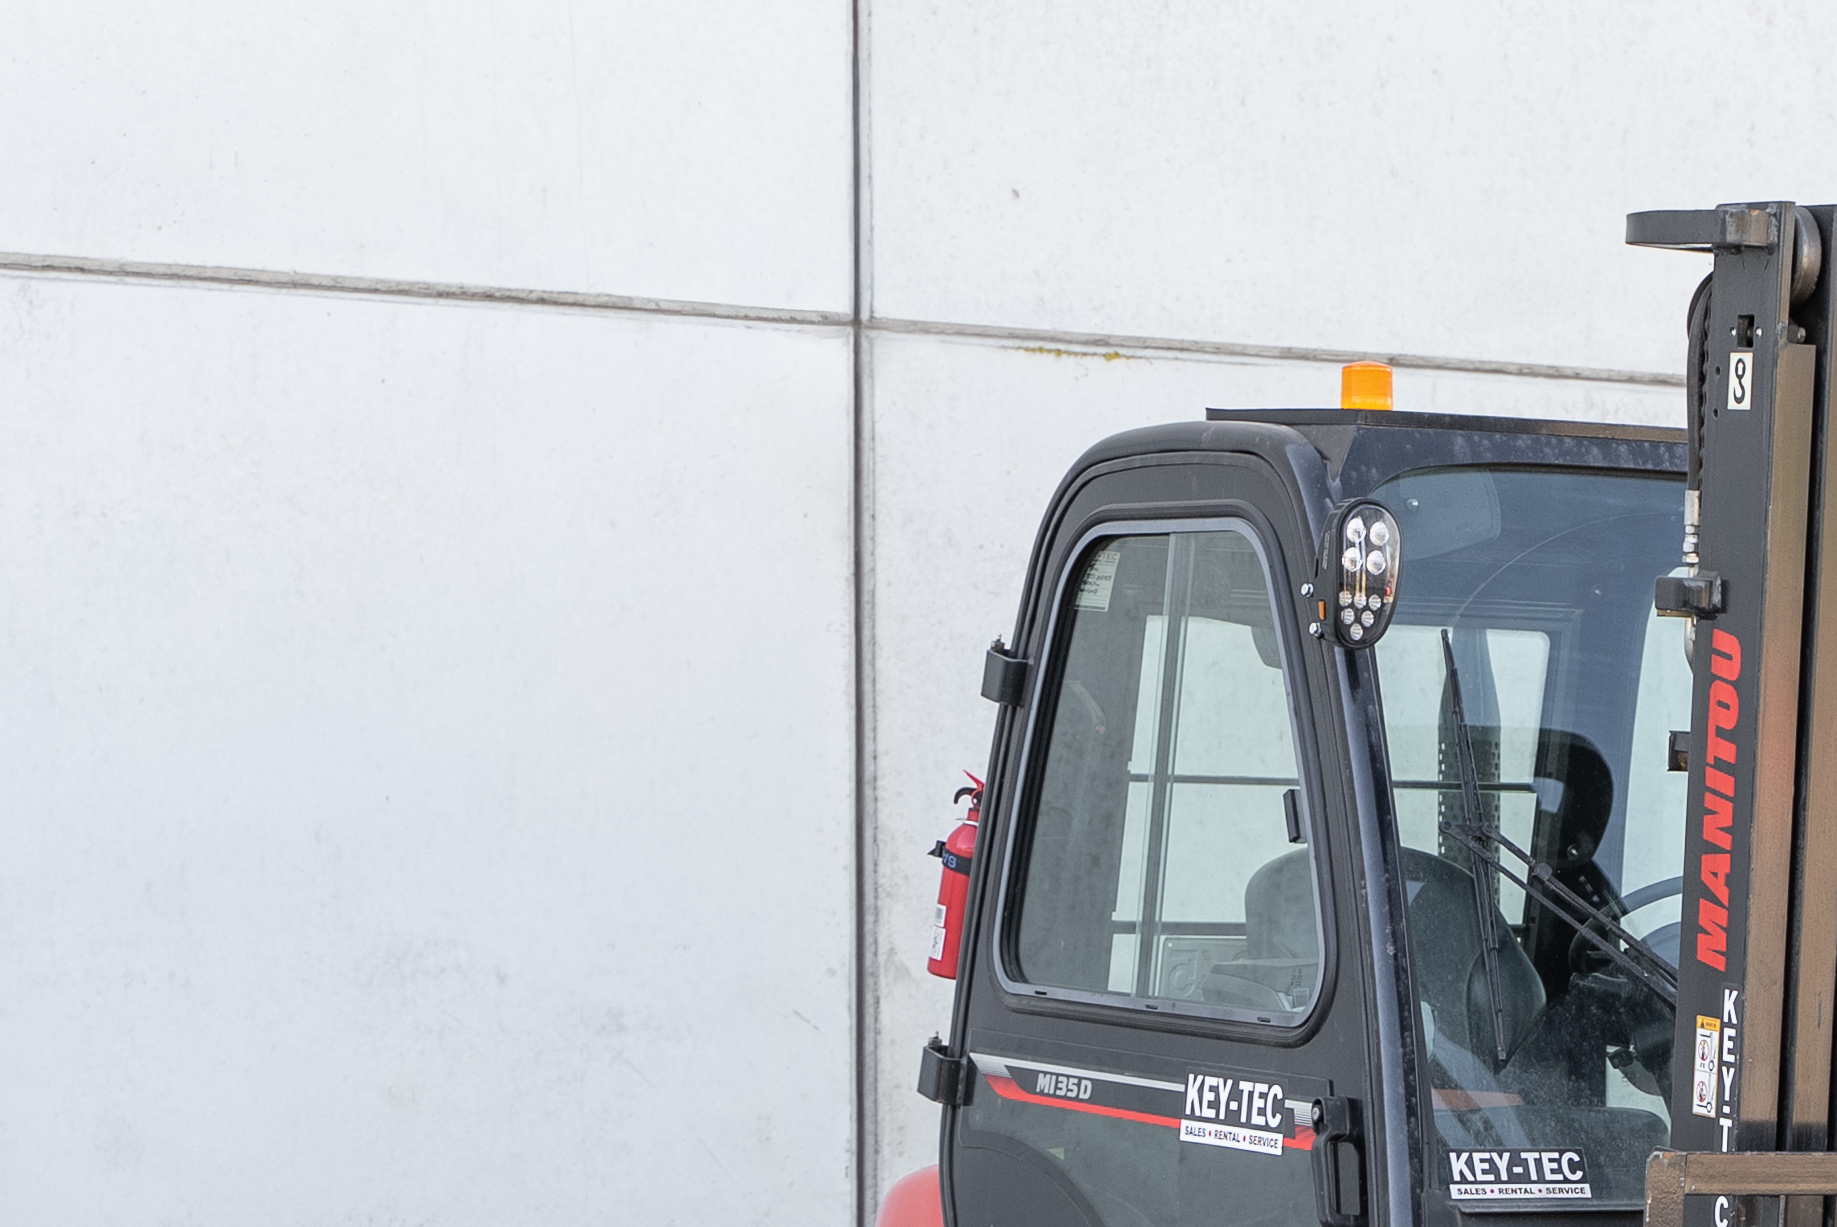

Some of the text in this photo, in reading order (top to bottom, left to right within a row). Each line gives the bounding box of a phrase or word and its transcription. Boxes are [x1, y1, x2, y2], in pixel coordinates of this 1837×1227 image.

[1697, 629, 1741, 972] MANITOU
[1036, 1073, 1093, 1100] MI35D
[1185, 1073, 1284, 1128] KEY-TEC
[1185, 1125, 1279, 1148] SALES RENTAL SERVICE
[1449, 1151, 1584, 1182] KEY-TEC
[1457, 1186, 1587, 1195] SALES RENTAL SERVICE
